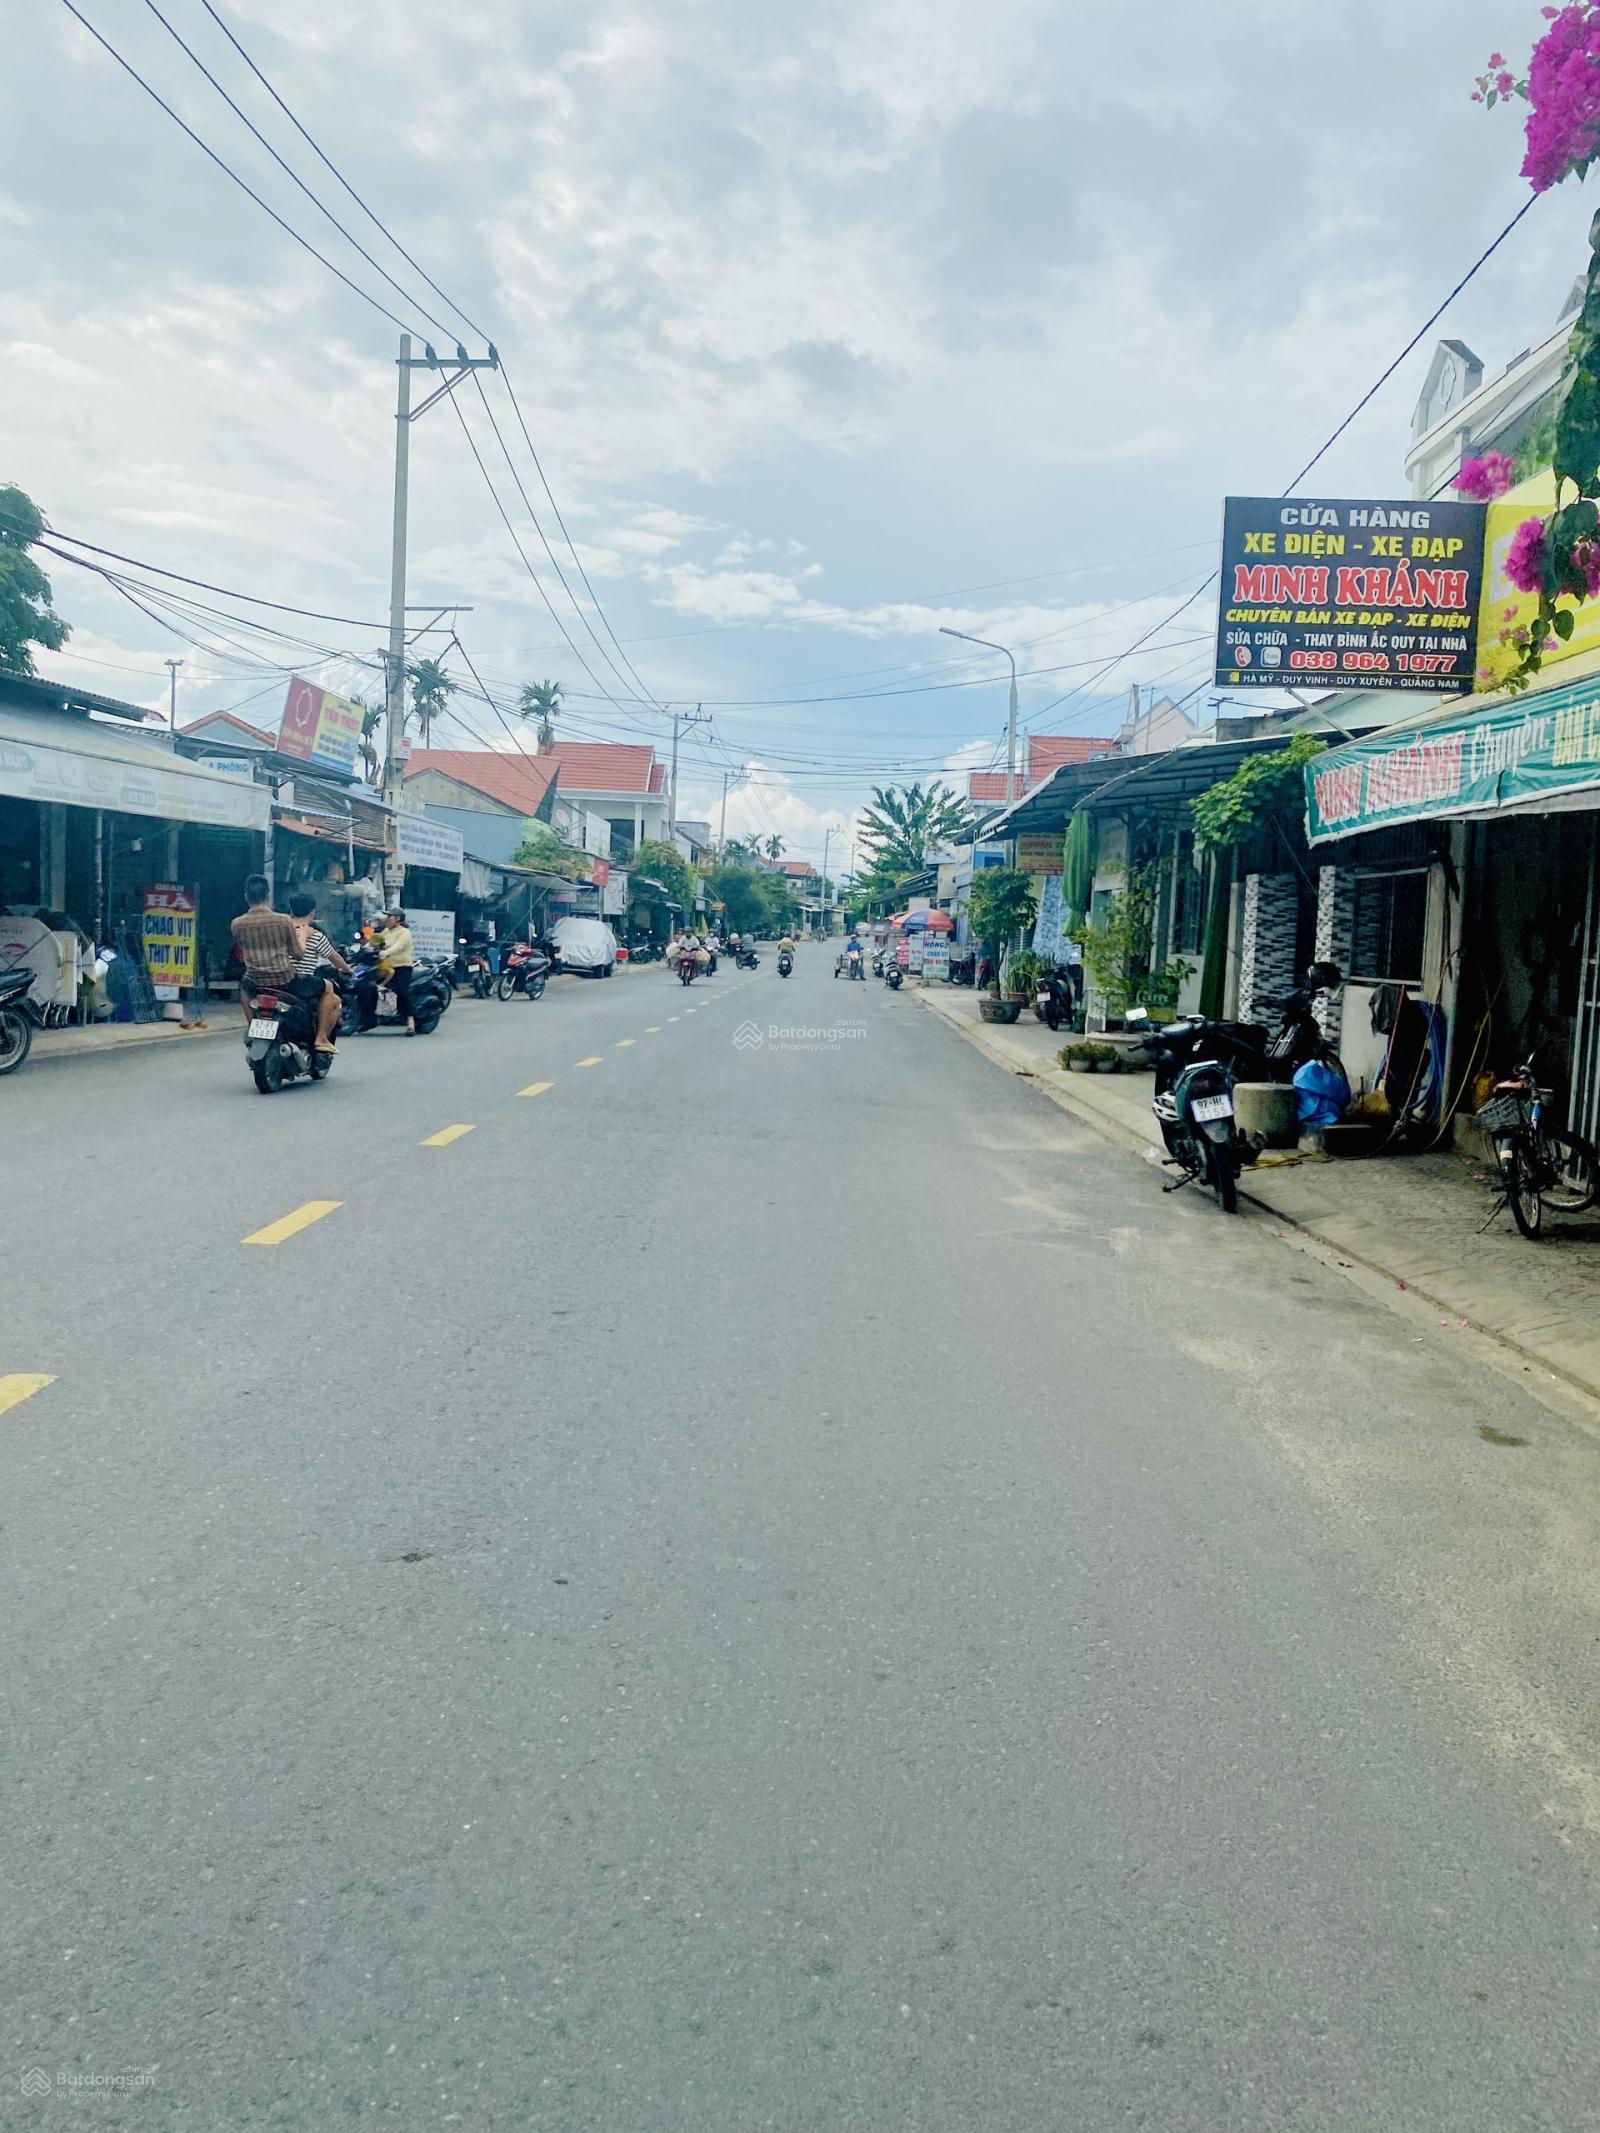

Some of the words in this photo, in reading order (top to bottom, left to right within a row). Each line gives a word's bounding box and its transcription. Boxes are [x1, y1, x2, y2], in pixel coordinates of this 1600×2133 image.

[1280, 503, 1340, 526] CỬA
[1350, 507, 1430, 528] HÀNG
[1244, 532, 1276, 553] XE
[1285, 531, 1344, 559] ĐIỆN
[1370, 536, 1409, 556] XE
[1411, 537, 1463, 562] ĐẠP
[1233, 564, 1330, 604] MINH
[1336, 558, 1469, 609] KHÁNH
[1226, 607, 1292, 624] CHUYÊN
[1295, 607, 1330, 624] BÁN
[1333, 611, 1357, 625] XE
[1358, 612, 1393, 629] ĐẠP
[1405, 613, 1429, 626] XE
[1430, 612, 1472, 631] ĐIỆN
[1226, 627, 1252, 644] SỬA
[1255, 630, 1288, 645] CHỮA
[1304, 633, 1334, 647] THAY
[1337, 632, 1367, 648] BÌNH
[1370, 632, 1389, 648] ẮC
[1392, 636, 1416, 649] QUY
[1418, 636, 1439, 652] TẠI
[1441, 634, 1467, 650] NHÀ
[1290, 651, 1337, 668] 038
[1343, 652, 1389, 670] 964
[1396, 654, 1457, 672] 1977
[1243, 672, 1256, 683] HÀ
[1260, 672, 1273, 683] MỸ
[1283, 675, 1302, 684] DUY
[1305, 675, 1328, 685] VINH
[1337, 676, 1357, 685] DUY
[1360, 675, 1392, 686] XUYÊN
[1401, 676, 1435, 687] QUẢNG
[1438, 679, 1459, 688] NAM
